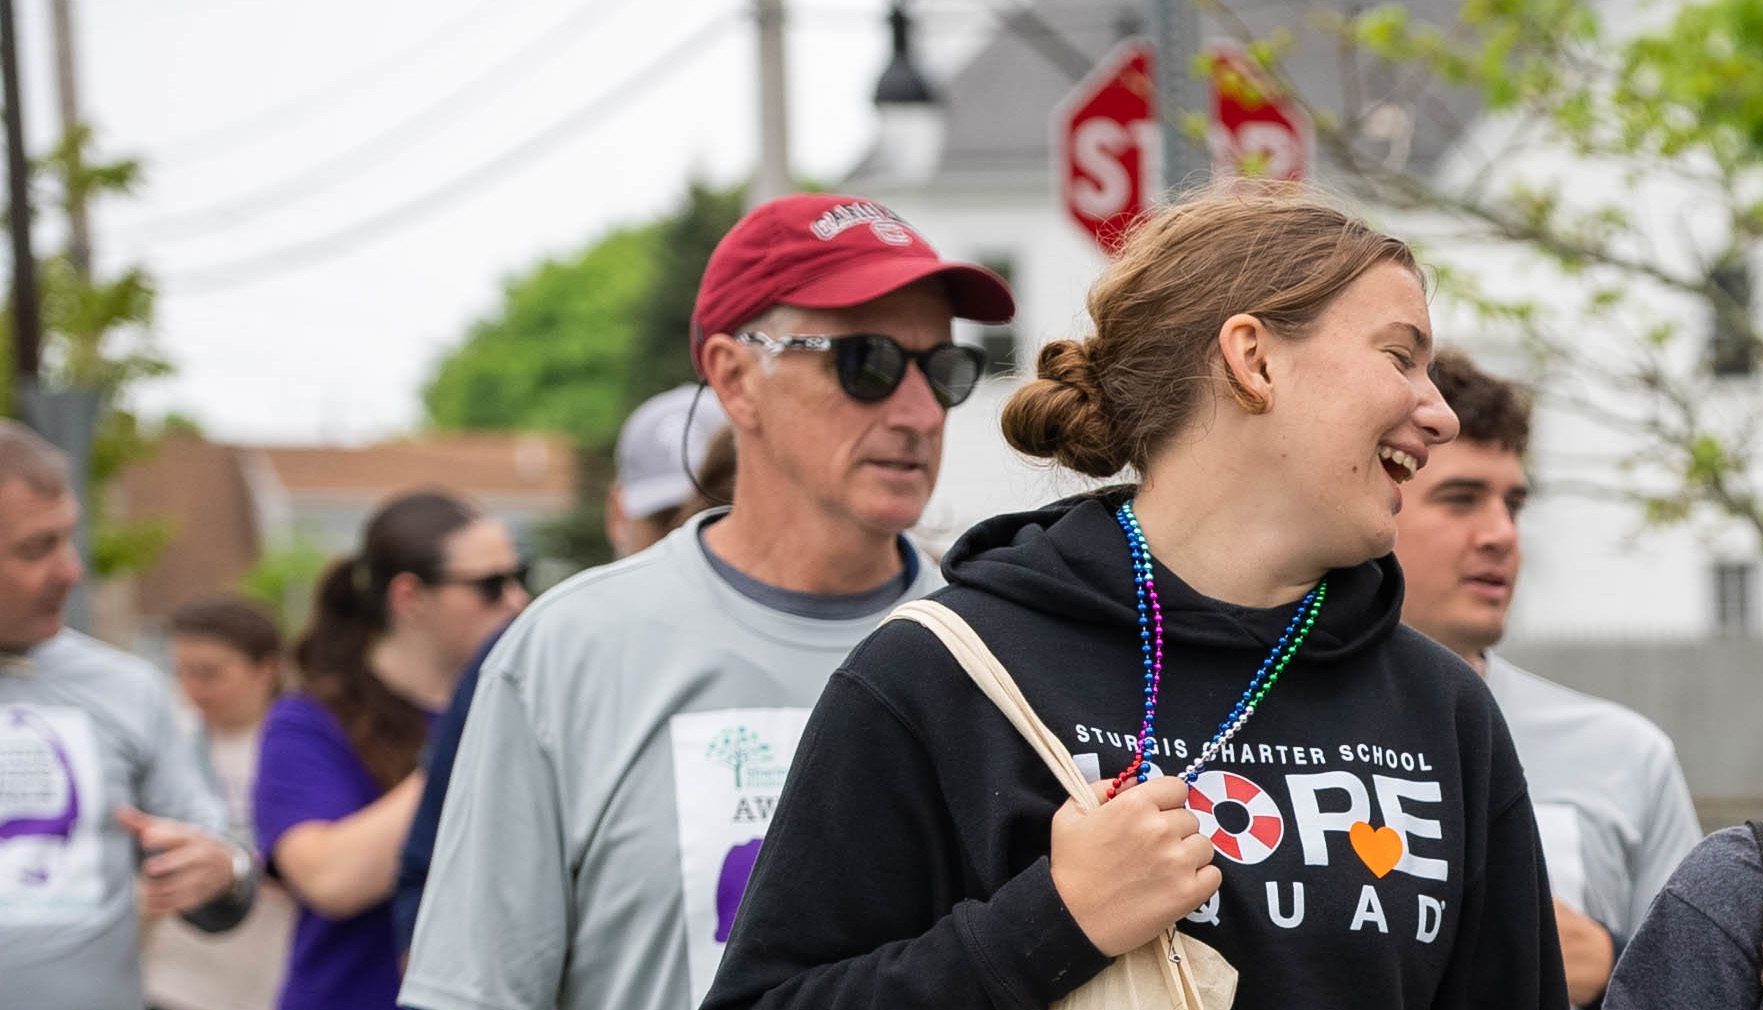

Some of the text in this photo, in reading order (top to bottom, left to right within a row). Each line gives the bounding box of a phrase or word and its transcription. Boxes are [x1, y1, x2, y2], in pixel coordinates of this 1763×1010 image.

[1073, 116, 1295, 220] STP
[1076, 724, 1432, 771] STURGIS CHARTER SCHOOL
[1073, 753, 1449, 882] OPE
[1184, 881, 1442, 944] QUAD
